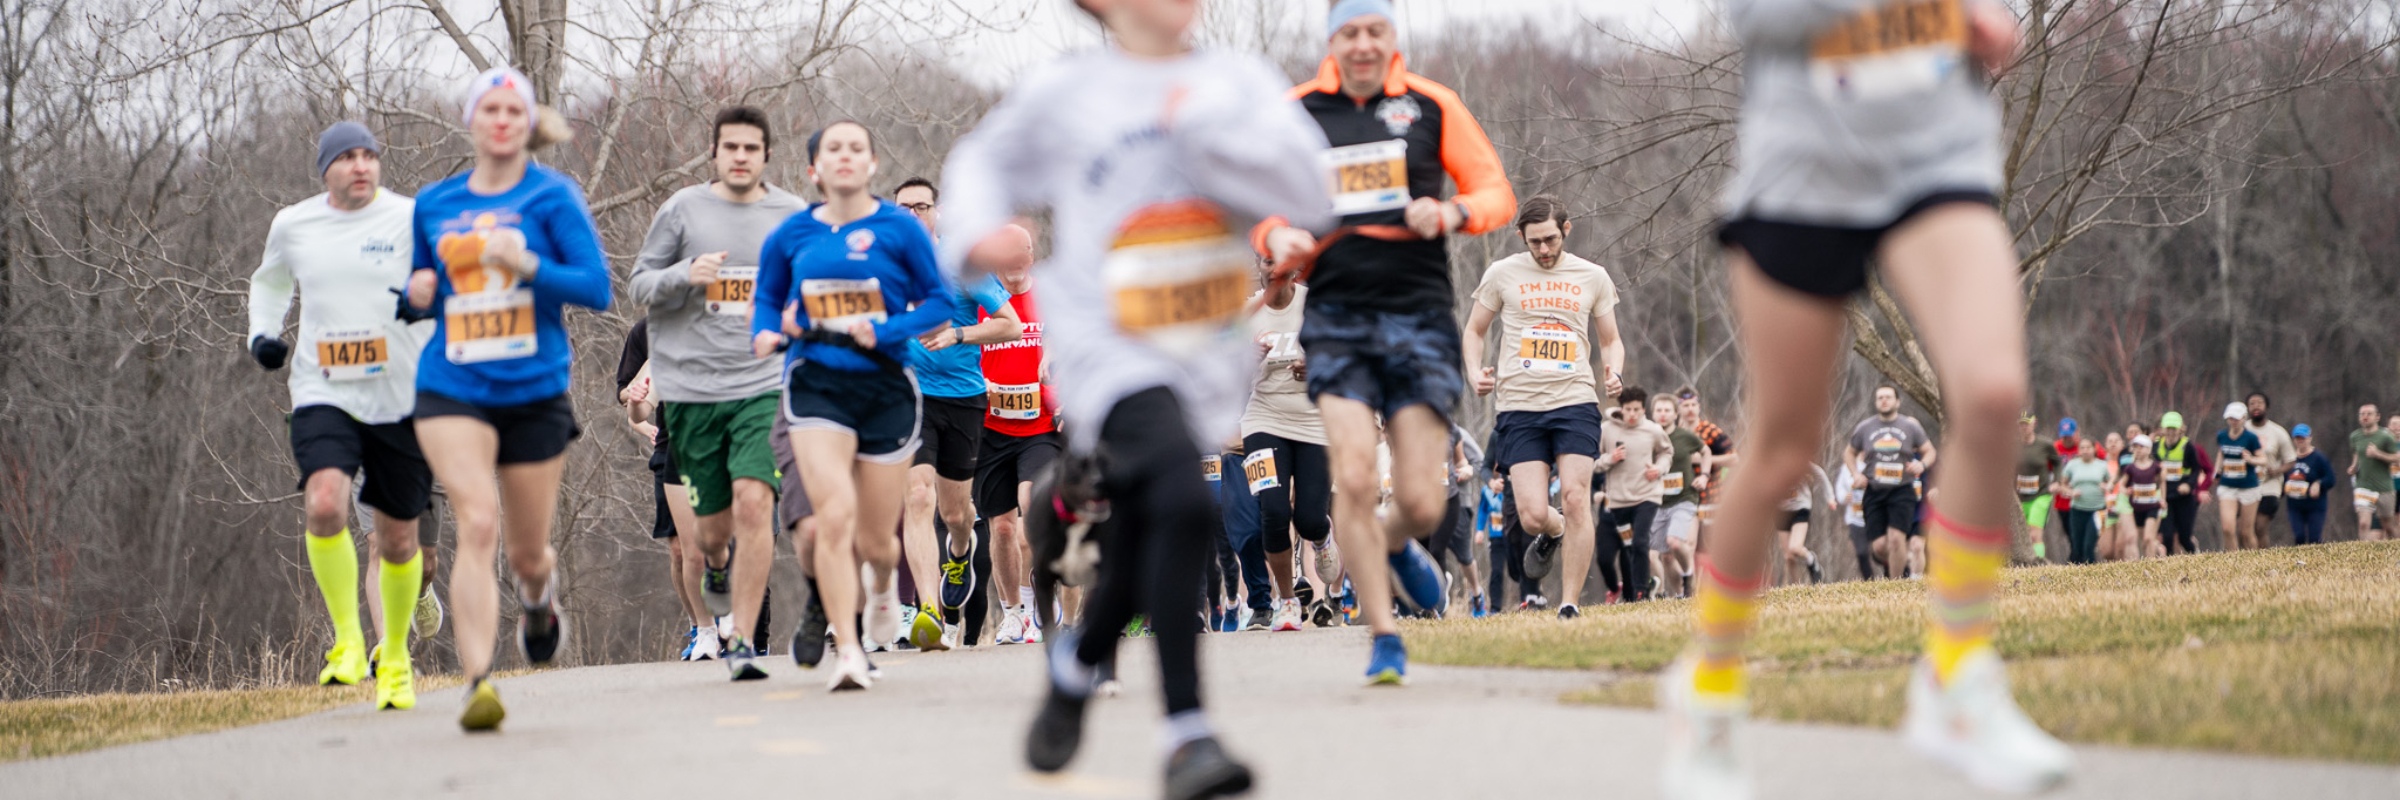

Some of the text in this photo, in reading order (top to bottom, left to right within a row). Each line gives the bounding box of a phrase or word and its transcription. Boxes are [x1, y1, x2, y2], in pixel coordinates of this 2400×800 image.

[721, 279, 753, 301] 139
[1519, 281, 1582, 296] I'M INTO
[819, 291, 872, 319] 1153
[1520, 297, 1581, 312] FITNESS
[463, 307, 519, 340] 1337
[327, 339, 377, 366] 1475
[1531, 340, 1567, 360] 1401
[998, 393, 1033, 410] 1419
[1202, 461, 1216, 474] 25
